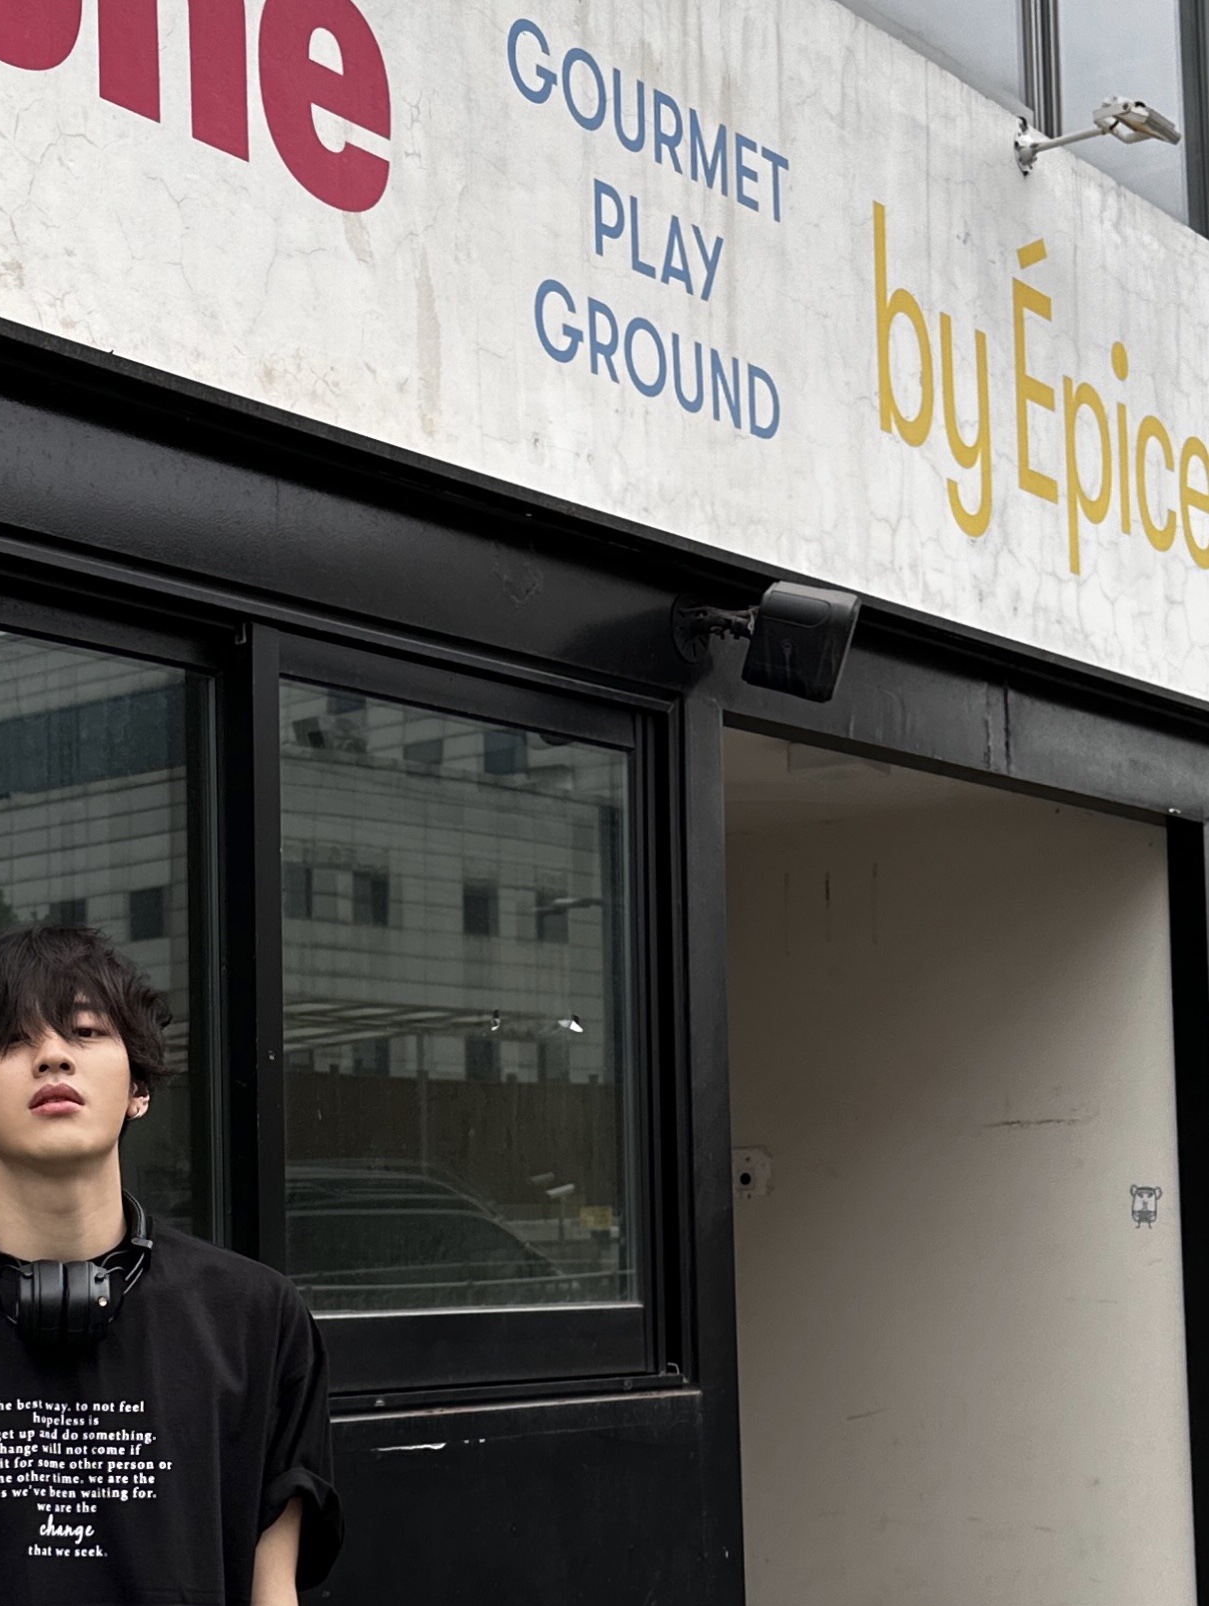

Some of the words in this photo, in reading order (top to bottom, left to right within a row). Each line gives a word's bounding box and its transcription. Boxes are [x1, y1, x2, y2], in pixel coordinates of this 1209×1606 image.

[507, 18, 789, 223] GOURMET
[594, 178, 723, 302] PLAY
[535, 279, 780, 440] GROUND
[873, 200, 992, 538] by
[16, 1398, 43, 1411] best
[44, 1402, 72, 1414] way.
[75, 1402, 89, 1412] to
[92, 1402, 115, 1413] not
[118, 1400, 145, 1413] feel
[32, 1411, 85, 1429] hopeless
[88, 1414, 100, 1426] is
[18, 1429, 36, 1442] up
[39, 1428, 58, 1441] and
[61, 1428, 79, 1441] do
[82, 1428, 157, 1445] something.
[41, 1442, 62, 1455] will
[65, 1445, 88, 1456] not
[91, 1446, 126, 1456] come
[129, 1443, 143, 1456] if
[13, 1456, 34, 1469] for
[37, 1458, 66, 1470] some
[68, 1457, 104, 1470] other
[107, 1460, 155, 1473] person
[158, 1460, 173, 1471] or
[88, 1475, 104, 1484] we
[107, 1475, 129, 1485] are
[133, 1472, 156, 1485] the
[11, 1484, 47, 1498] we've
[48, 1485, 77, 1499] been
[80, 1486, 129, 1502] waiting
[132, 1485, 157, 1499] for.
[36, 1502, 52, 1512] we
[54, 1503, 73, 1513] are
[76, 1500, 97, 1513] the
[39, 1513, 96, 1545] change
[27, 1543, 52, 1557] that
[55, 1547, 71, 1558] we
[74, 1544, 108, 1558] seek.
